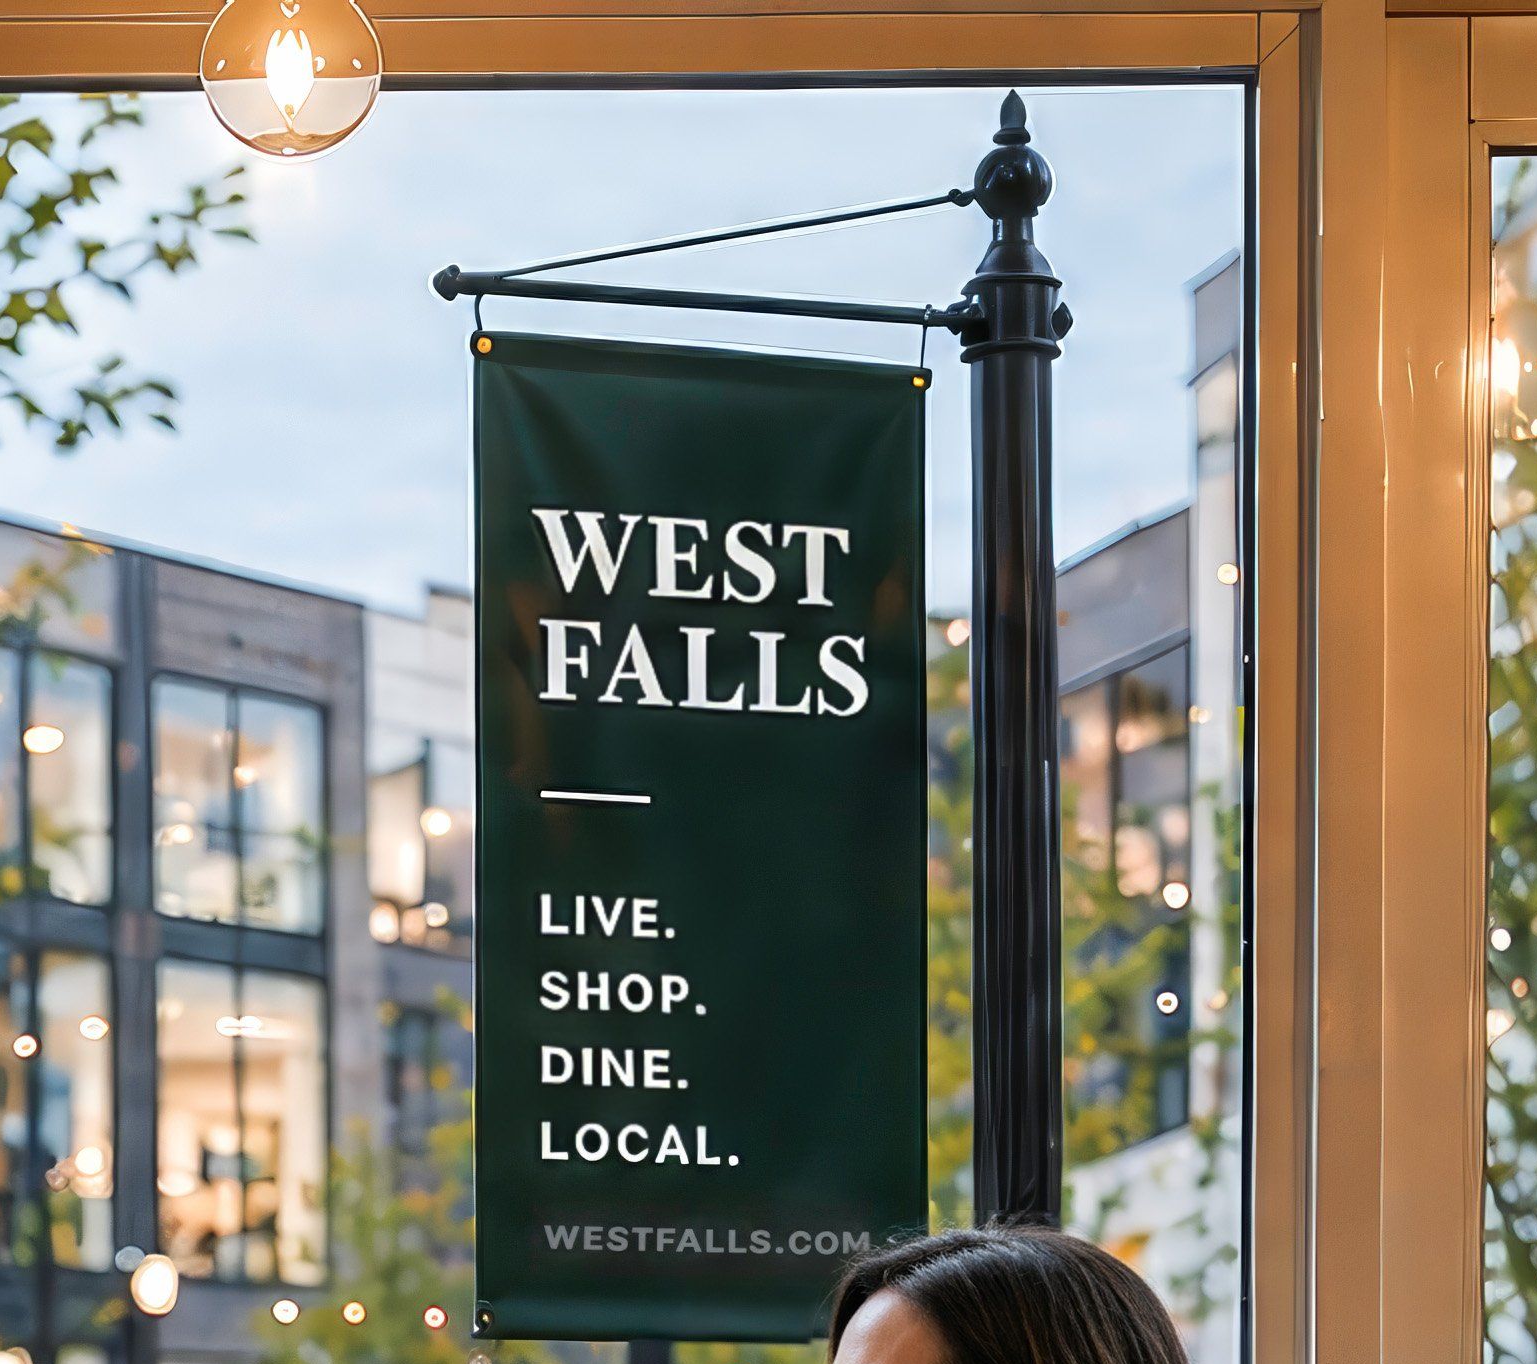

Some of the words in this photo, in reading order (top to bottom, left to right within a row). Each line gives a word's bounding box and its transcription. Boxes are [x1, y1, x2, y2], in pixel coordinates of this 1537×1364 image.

[531, 508, 851, 607] WEST
[538, 618, 870, 718] FALLS
[540, 893, 676, 939] LIVE.
[539, 970, 707, 1016] SHOP.
[541, 1045, 689, 1090] DINE.
[541, 1121, 740, 1167] LOCAL.
[543, 1224, 871, 1257] WESTFALLS.COM
